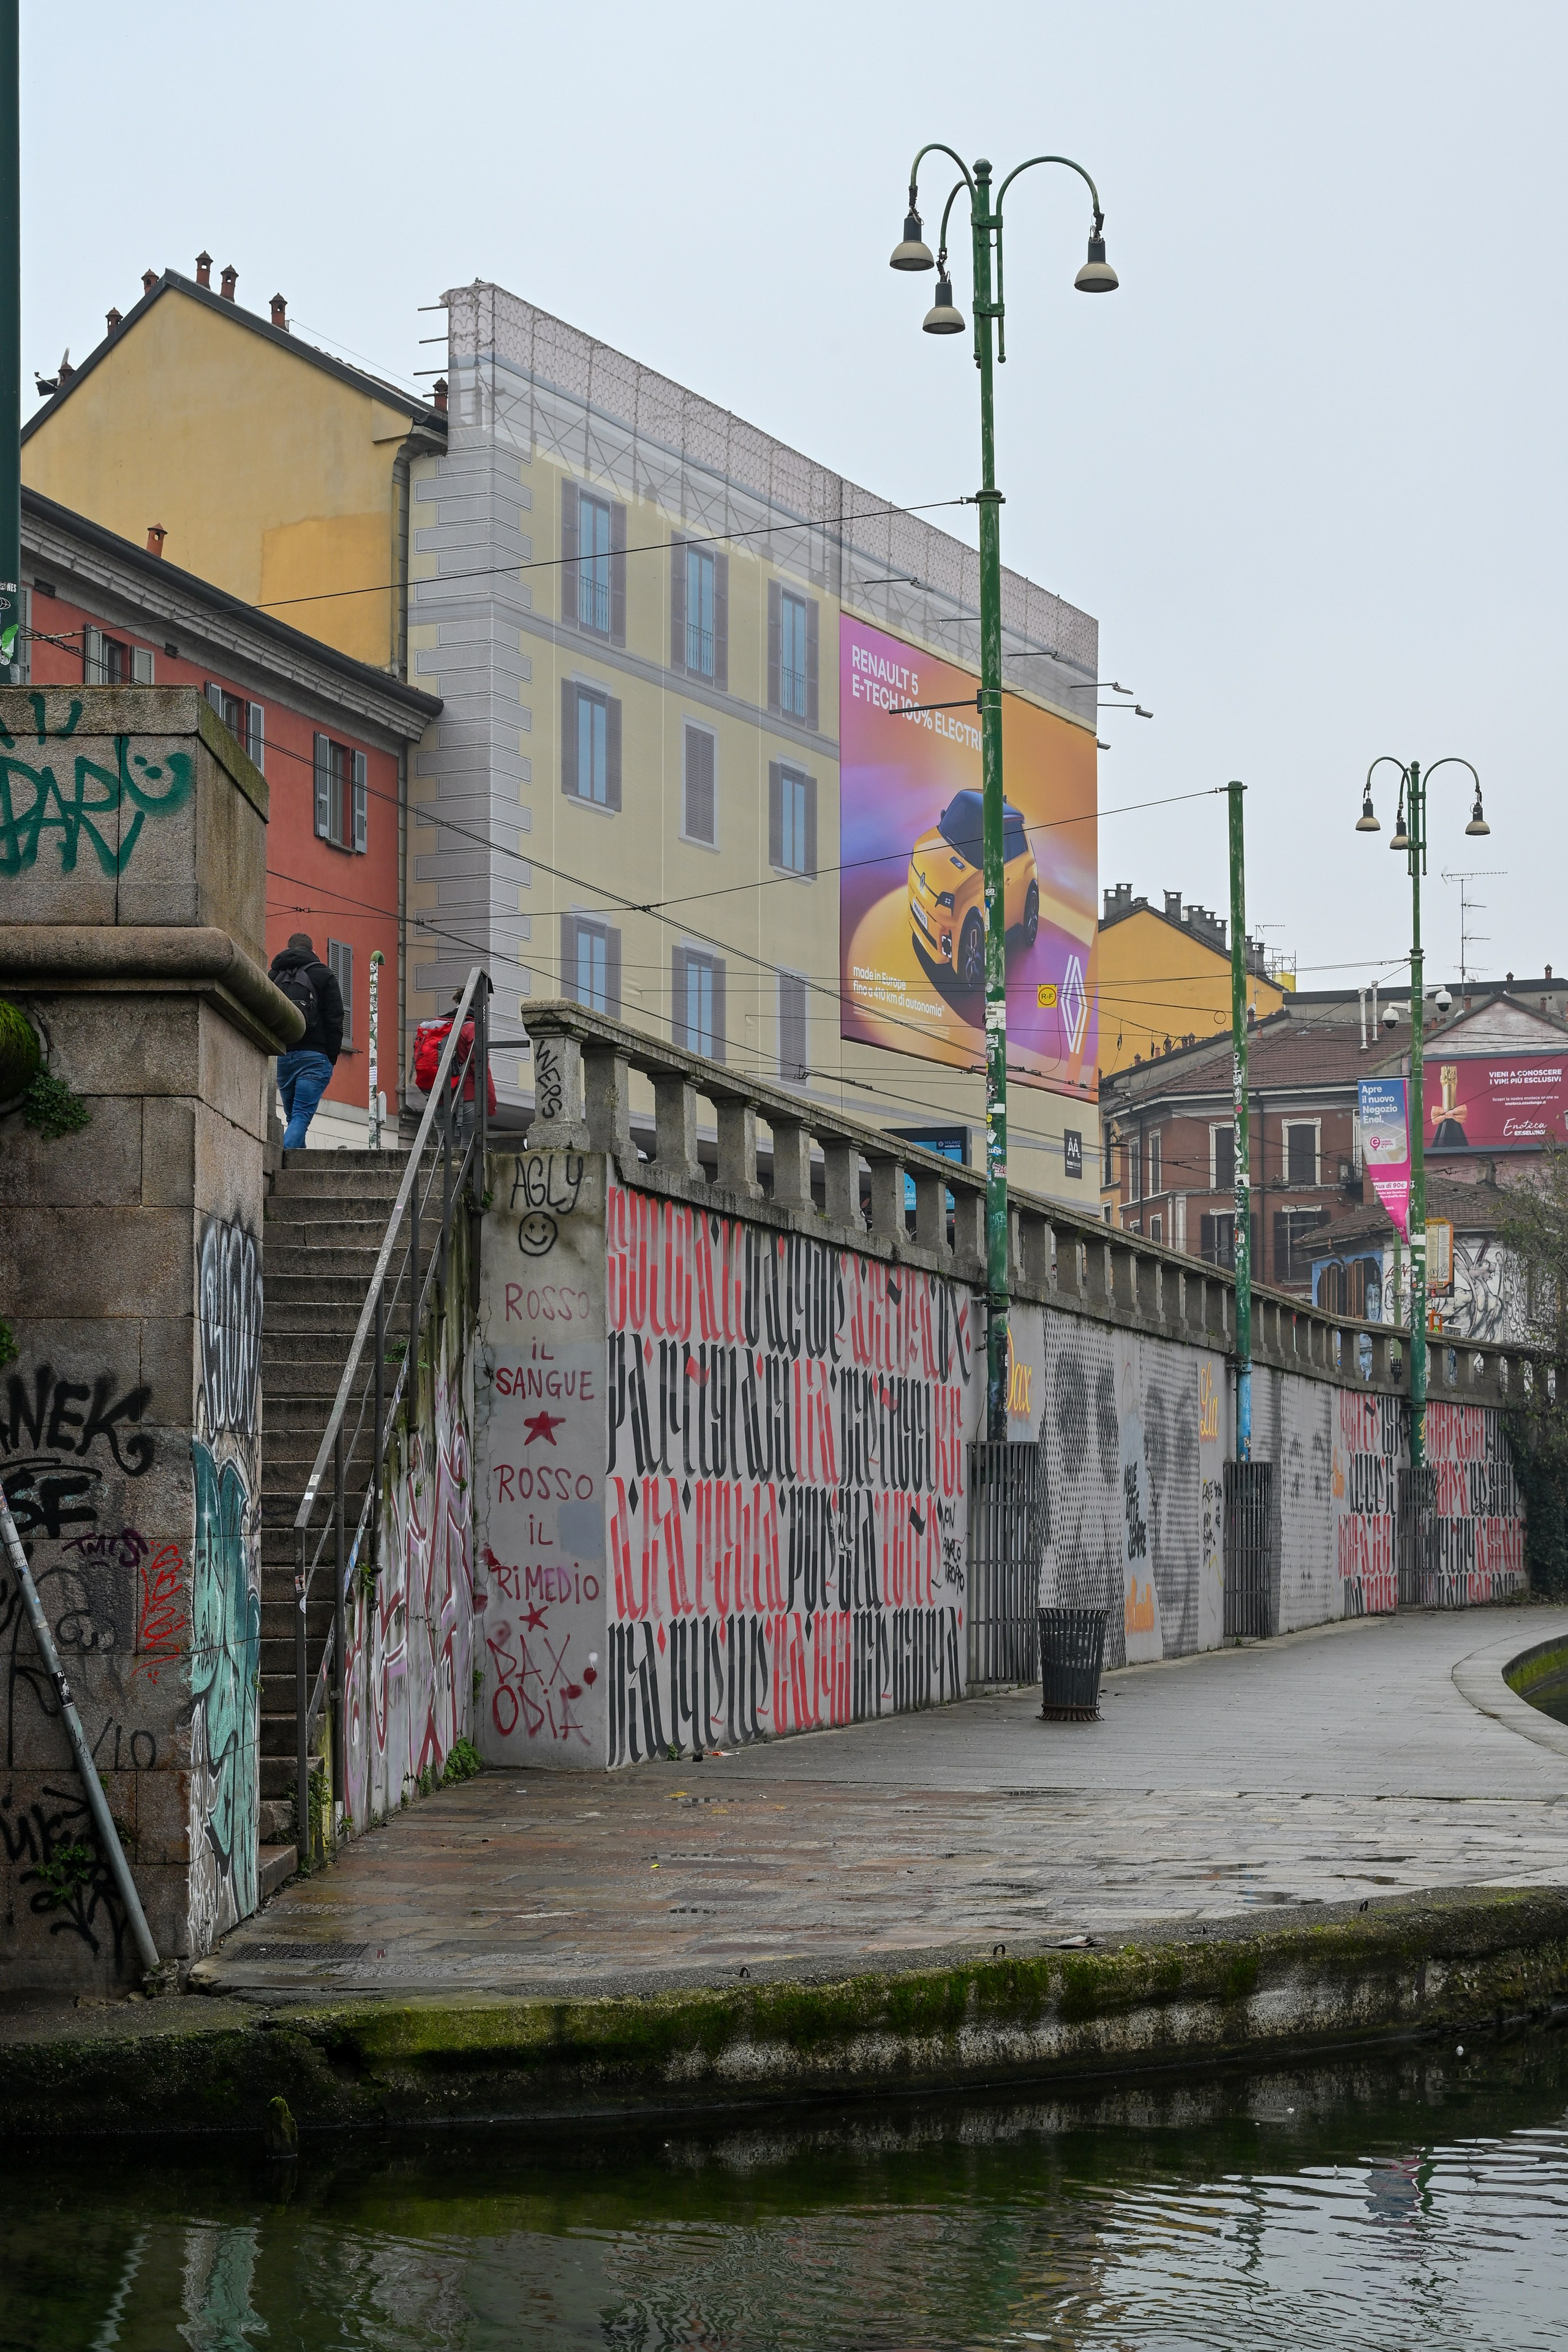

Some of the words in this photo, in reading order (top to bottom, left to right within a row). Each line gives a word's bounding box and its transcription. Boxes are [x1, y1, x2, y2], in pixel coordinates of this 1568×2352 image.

[852, 645, 909, 690] RENAULT
[911, 673, 918, 695] 5
[852, 674, 898, 711] E-TECH
[901, 695, 932, 730] 100%
[935, 711, 982, 752] ELECTRI
[853, 966, 873, 980] made
[875, 969, 881, 981] in
[882, 972, 906, 990] Europe
[853, 979, 867, 995] fino
[869, 988, 873, 998] a
[874, 986, 885, 1001] 410
[886, 989, 897, 1004] km
[898, 993, 905, 1006] di
[1362, 1085, 1382, 1095] Apre
[1363, 1104, 1398, 1115] Negozio
[1363, 1115, 1384, 1123] Enel.
[1503, 1118, 1547, 1136] Enoteca
[511, 1154, 583, 1215] AGLY
[505, 1282, 590, 1322] ROSSO
[495, 1366, 595, 1402] SANGUE
[493, 1464, 594, 1503] ROSSO
[486, 1634, 571, 1686] DAX
